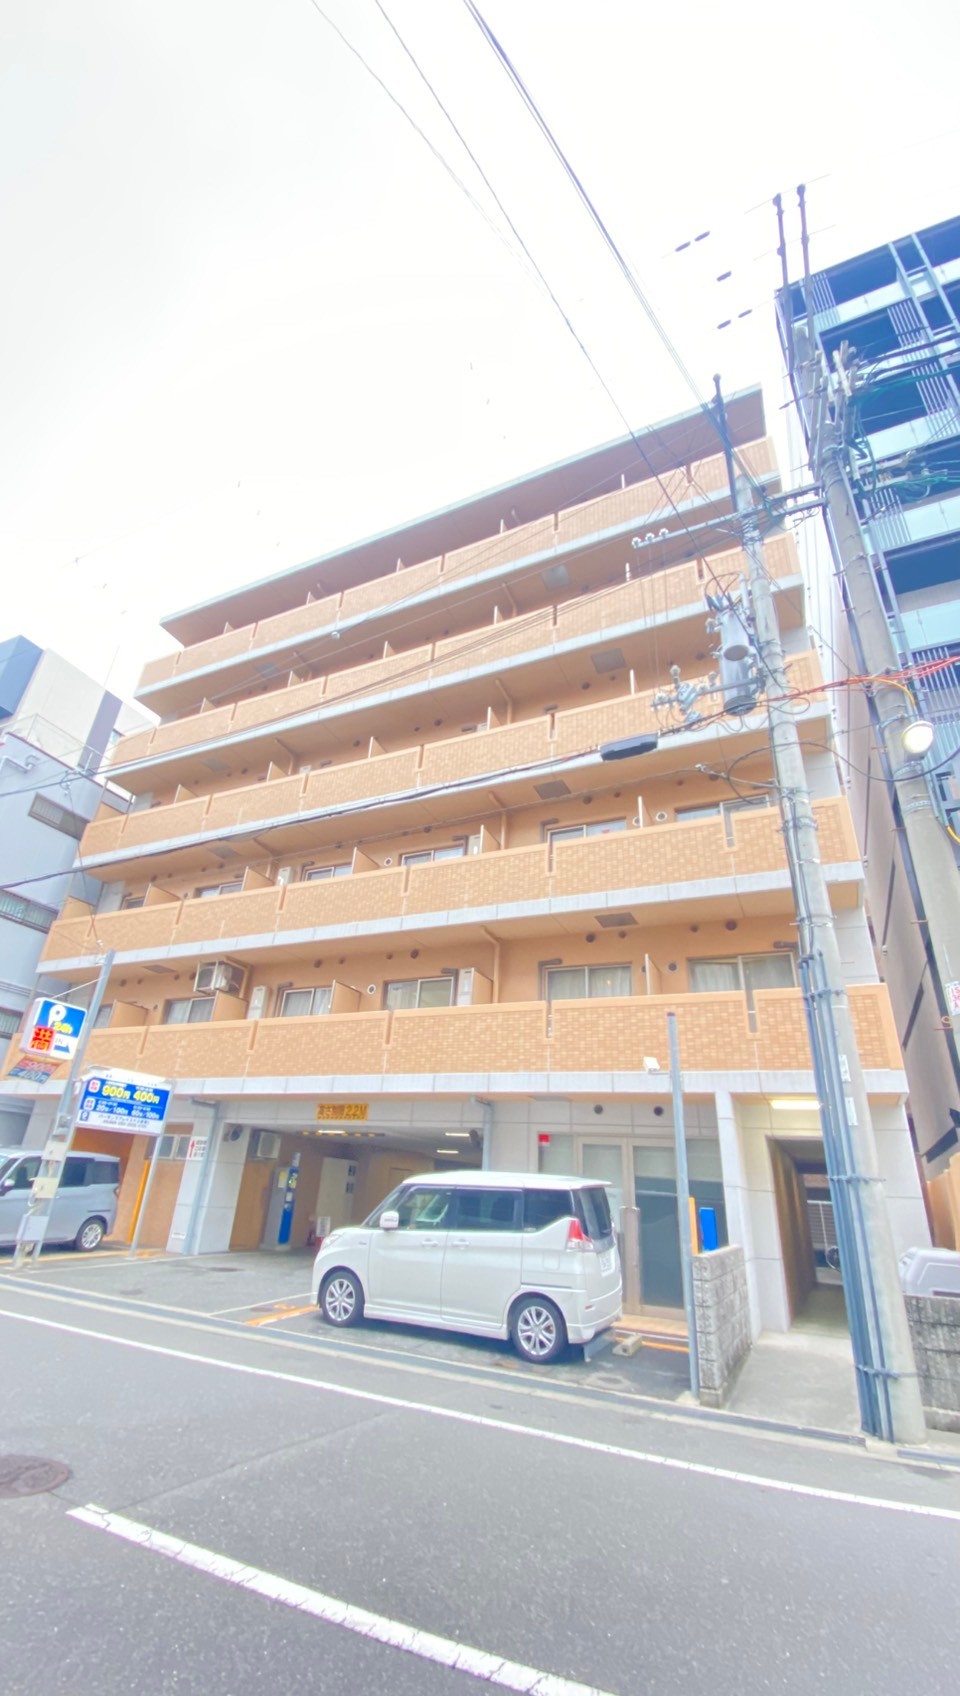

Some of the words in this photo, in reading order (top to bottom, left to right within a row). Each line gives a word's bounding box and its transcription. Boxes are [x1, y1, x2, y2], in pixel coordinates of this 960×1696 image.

[30, 1027, 54, 1051] 満
[101, 1084, 131, 1100] 900円
[133, 1091, 160, 1105] 400円
